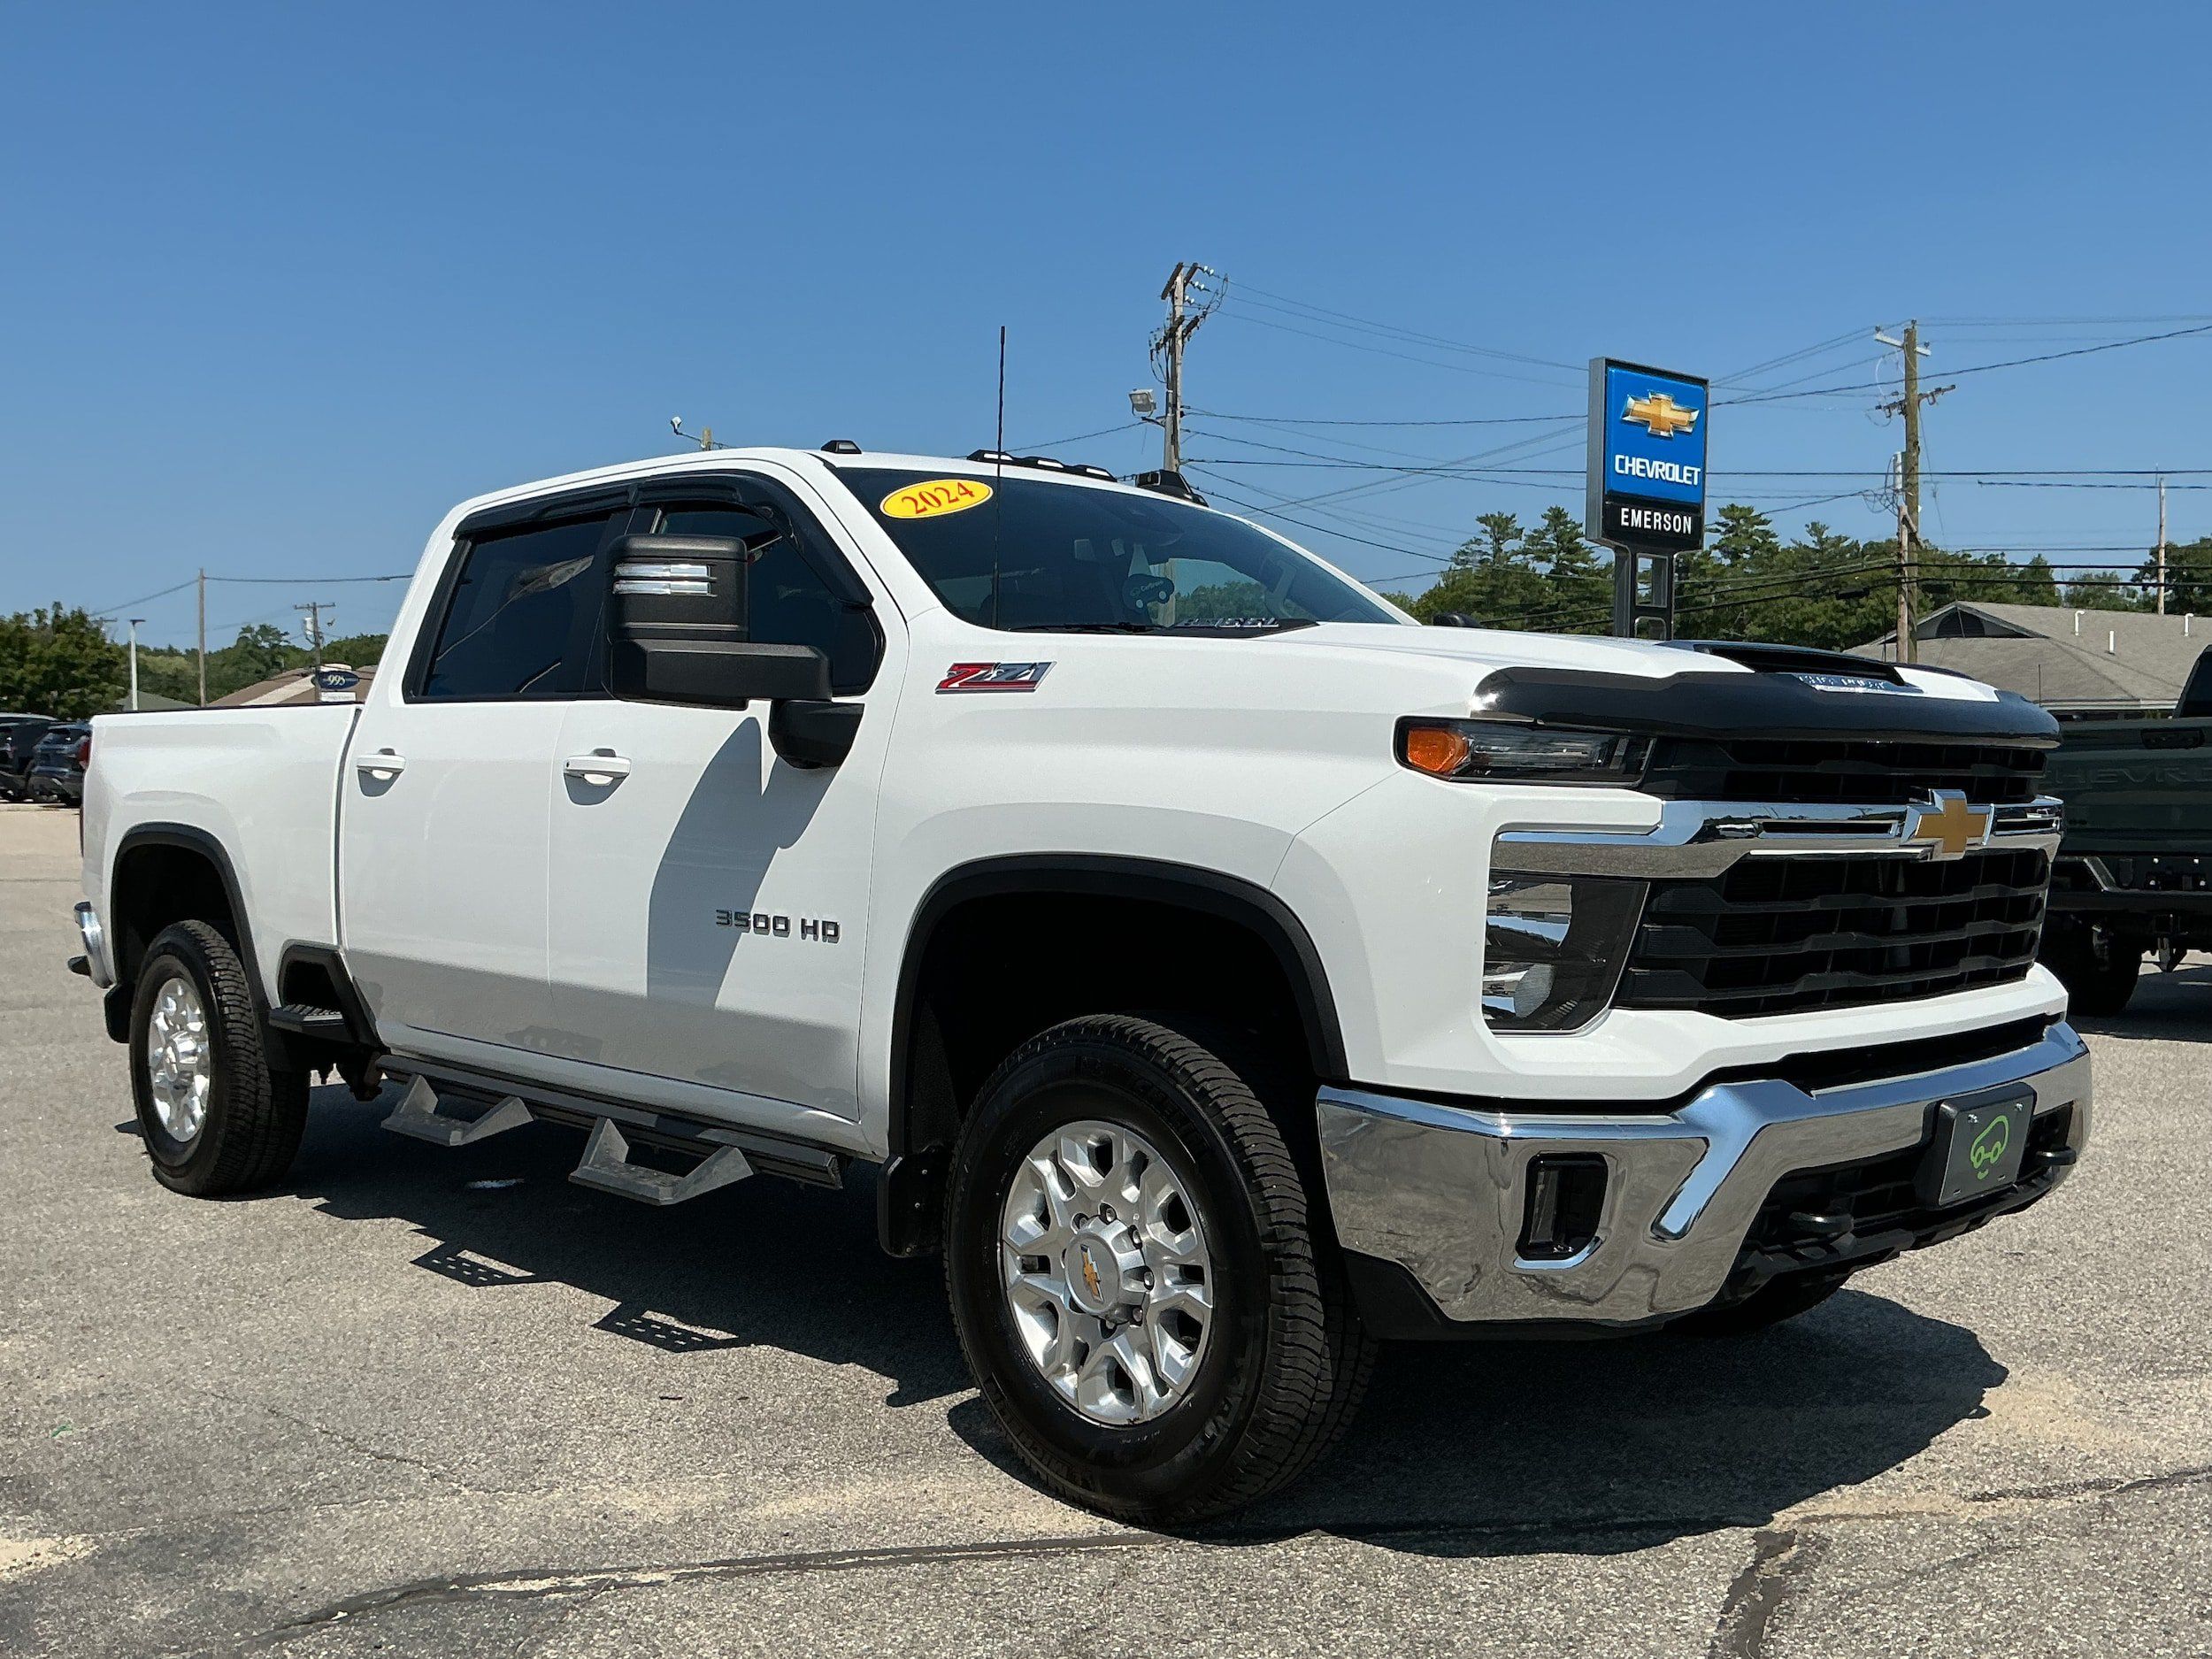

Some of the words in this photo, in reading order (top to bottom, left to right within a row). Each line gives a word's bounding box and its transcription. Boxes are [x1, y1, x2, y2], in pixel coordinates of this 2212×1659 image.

[1615, 454, 1701, 486] CHEVROLET
[901, 482, 975, 514] 2024
[1621, 508, 1692, 534] EMERSON
[716, 910, 790, 936] 3500
[801, 918, 841, 943] HD
